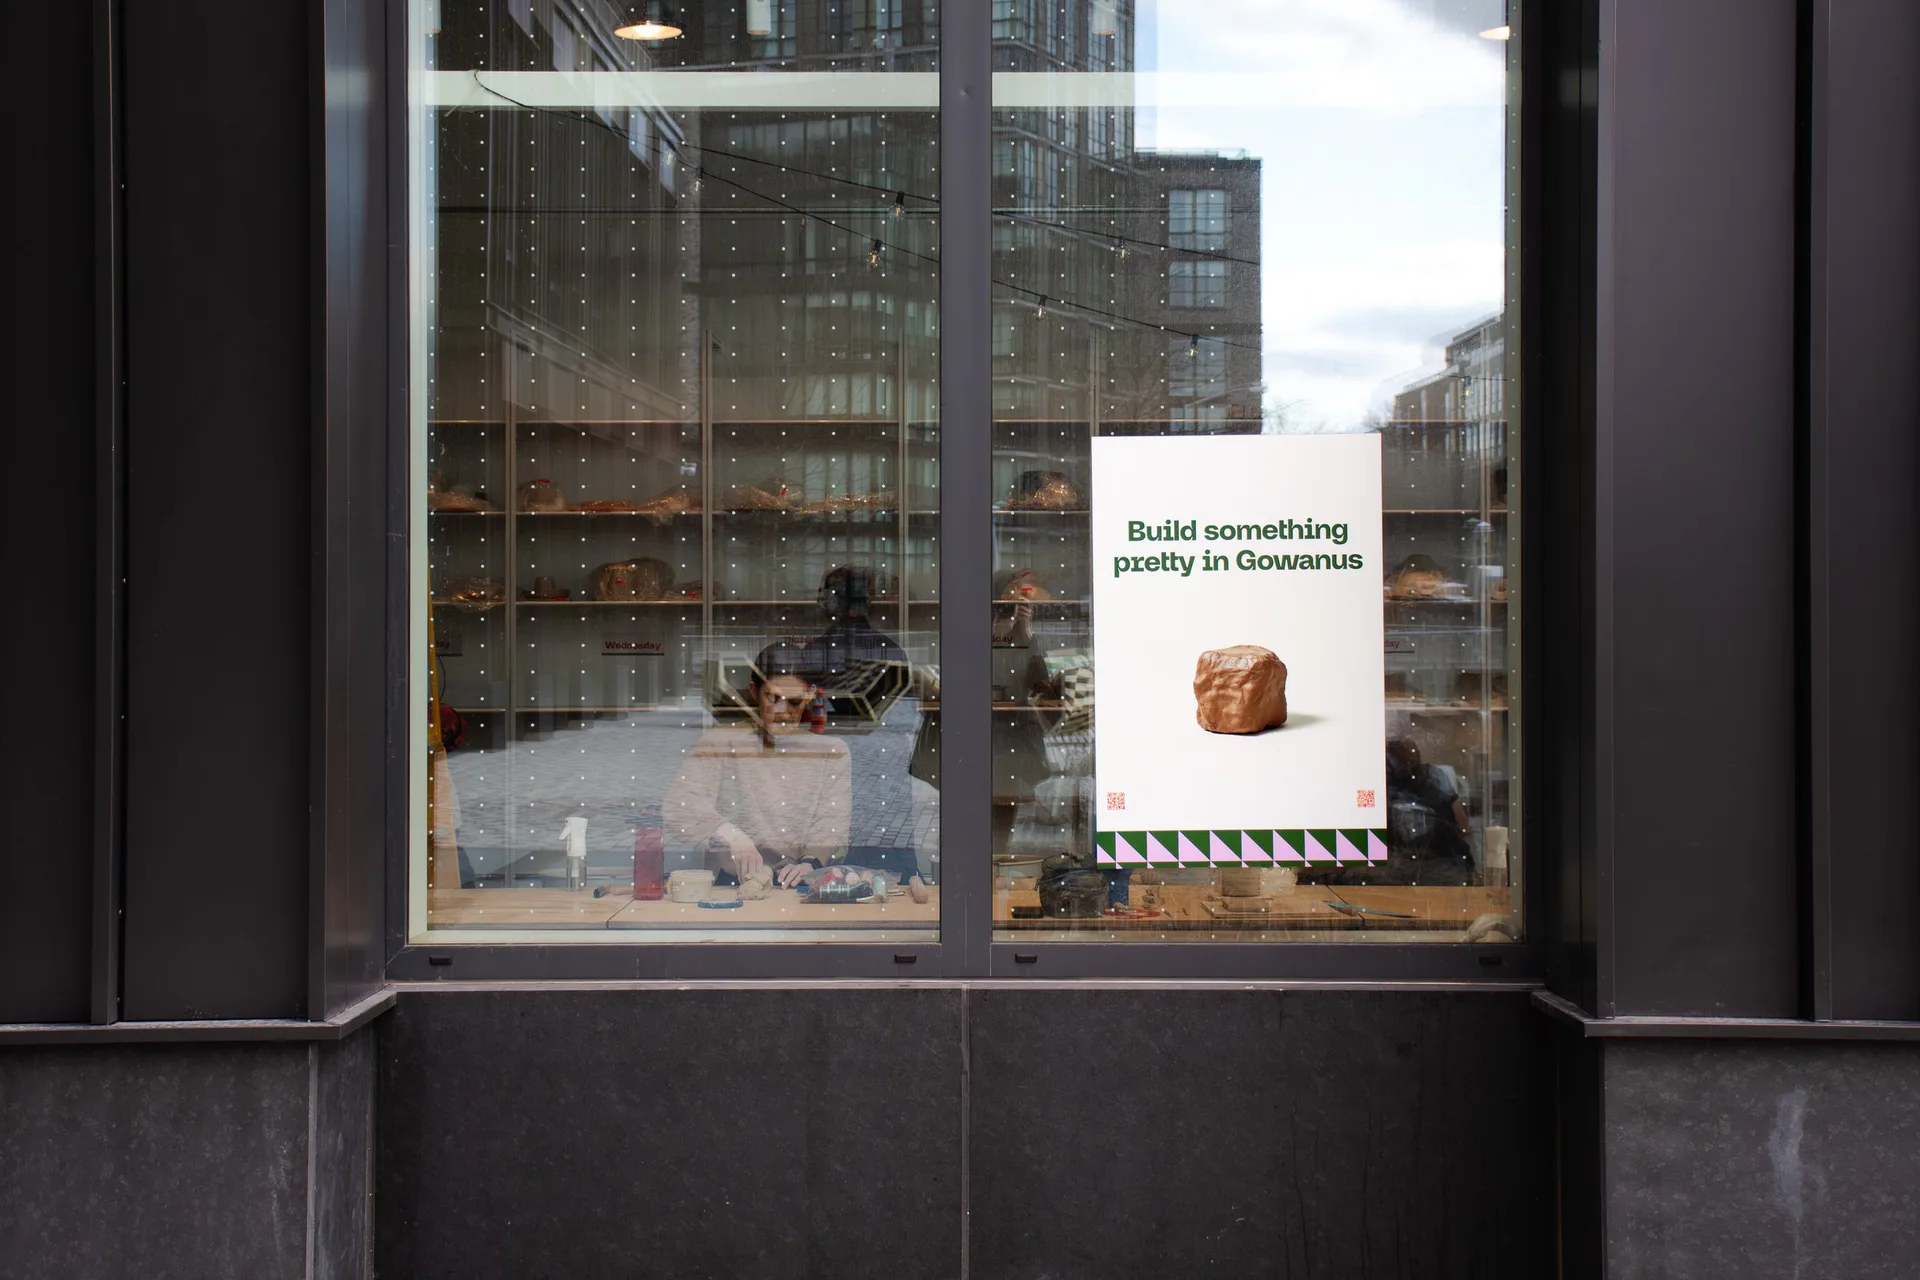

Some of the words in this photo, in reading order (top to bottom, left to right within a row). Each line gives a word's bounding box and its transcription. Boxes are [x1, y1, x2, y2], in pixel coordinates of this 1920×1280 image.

[1128, 520, 1197, 542] Build
[1204, 518, 1348, 545] something
[1114, 552, 1195, 578] pretty
[1202, 550, 1229, 571] in
[1236, 549, 1363, 571] Gowanus
